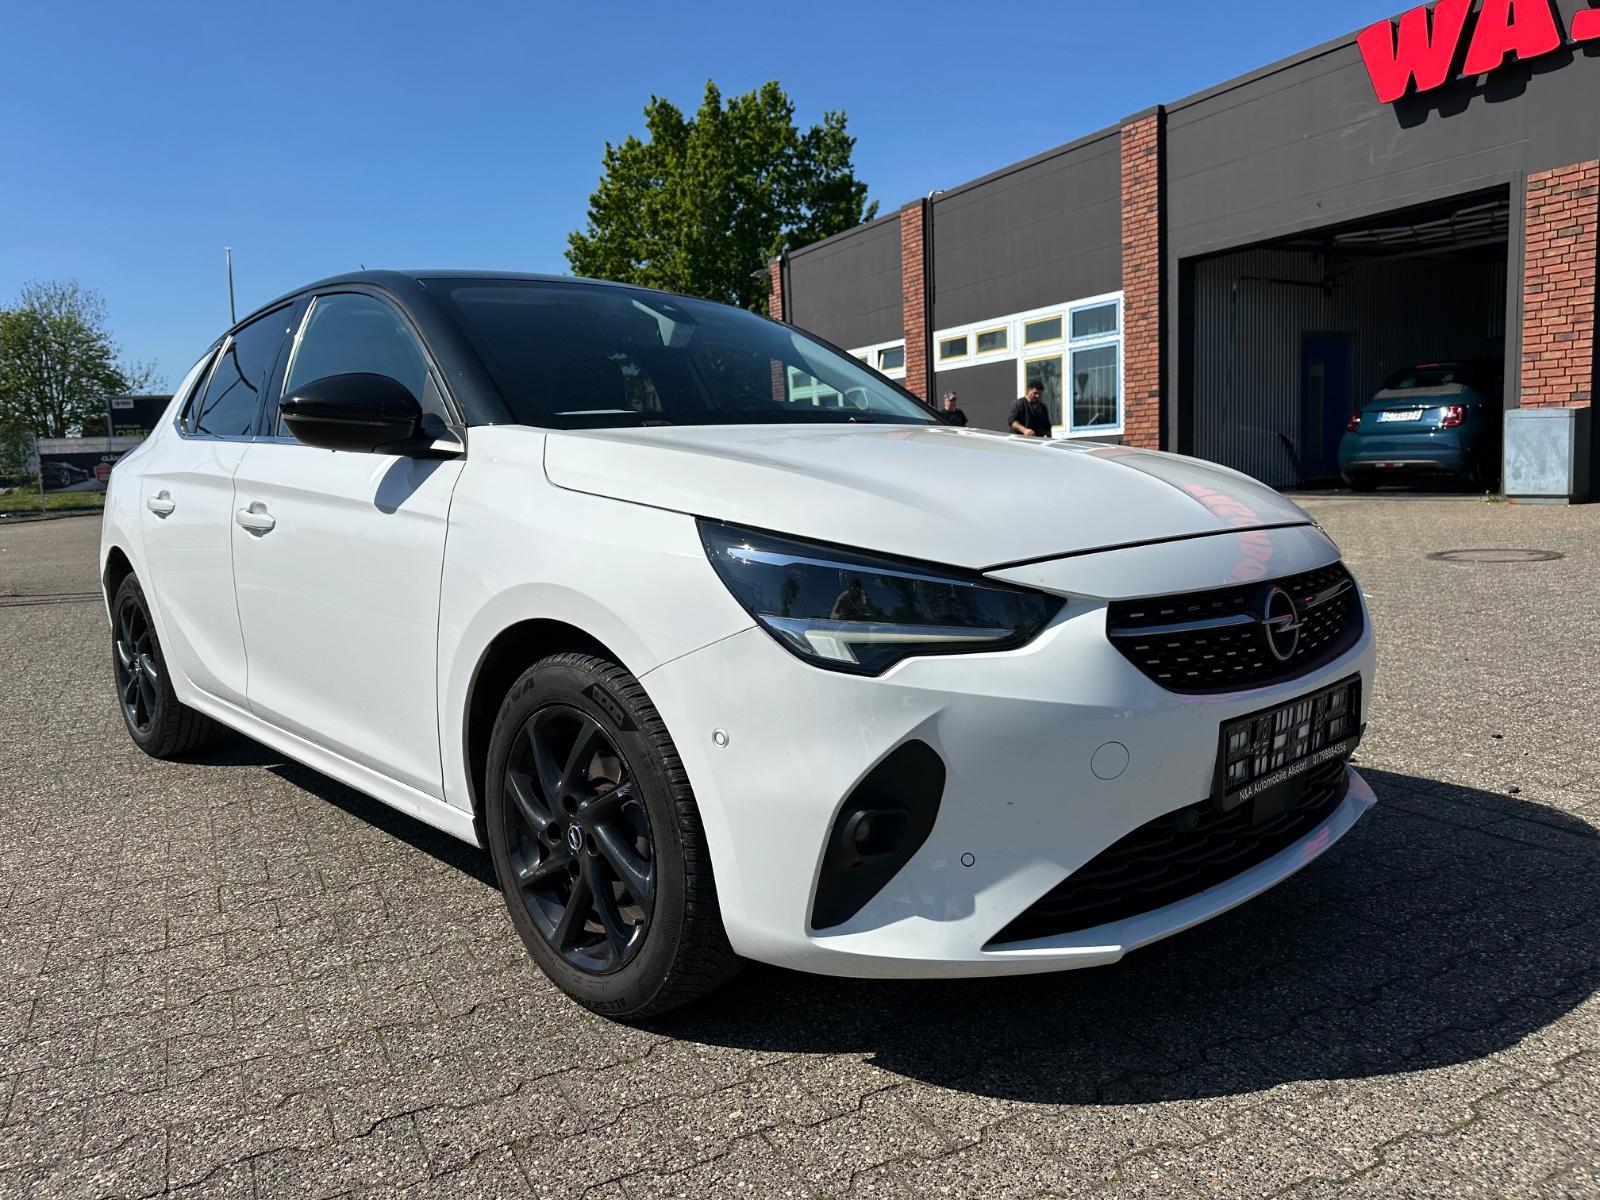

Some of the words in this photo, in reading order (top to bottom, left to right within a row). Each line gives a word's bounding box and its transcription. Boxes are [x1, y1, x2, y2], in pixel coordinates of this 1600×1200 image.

[1356, 0, 1600, 104] WA
[1239, 786, 1253, 801] N&A
[1254, 770, 1287, 793] Automobile
[1288, 759, 1307, 777] Alsdorf
